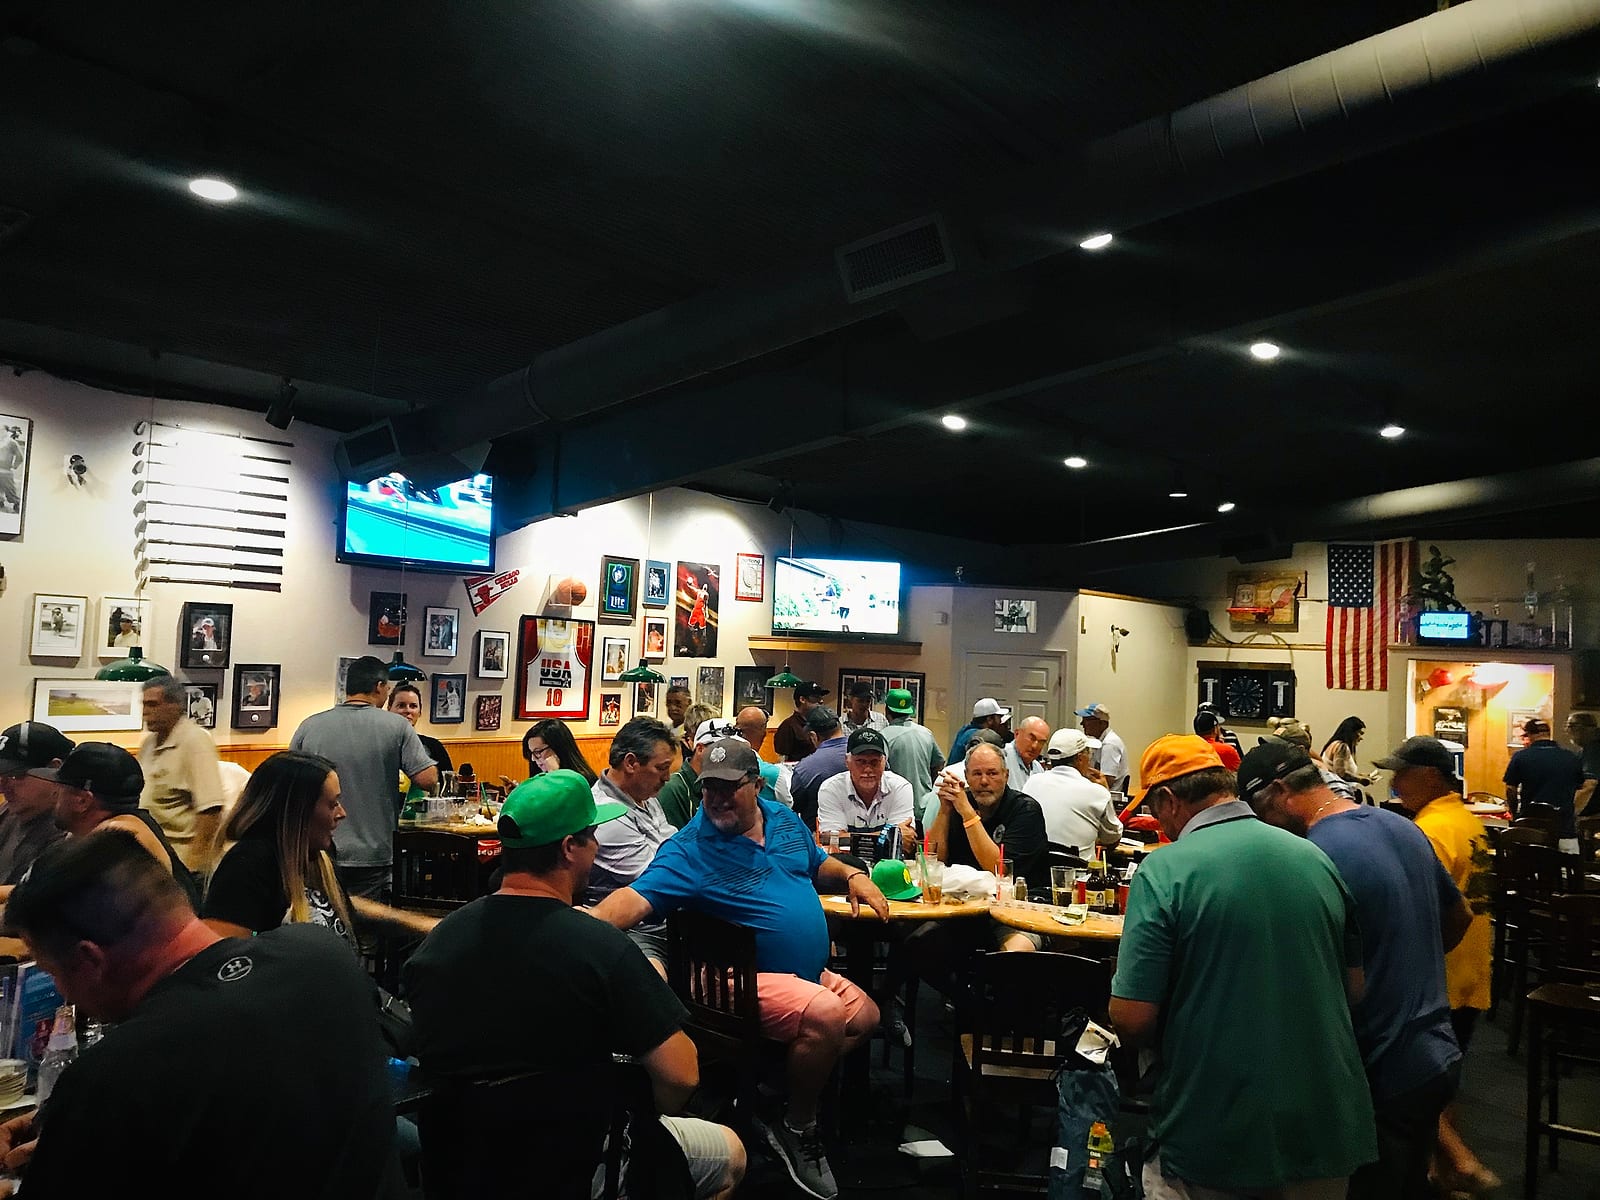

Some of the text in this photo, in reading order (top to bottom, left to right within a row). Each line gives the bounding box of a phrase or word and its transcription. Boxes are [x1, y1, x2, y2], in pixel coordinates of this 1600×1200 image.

[611, 595, 625, 607] Lite
[540, 658, 571, 678] USA
[546, 688, 563, 706] 10
